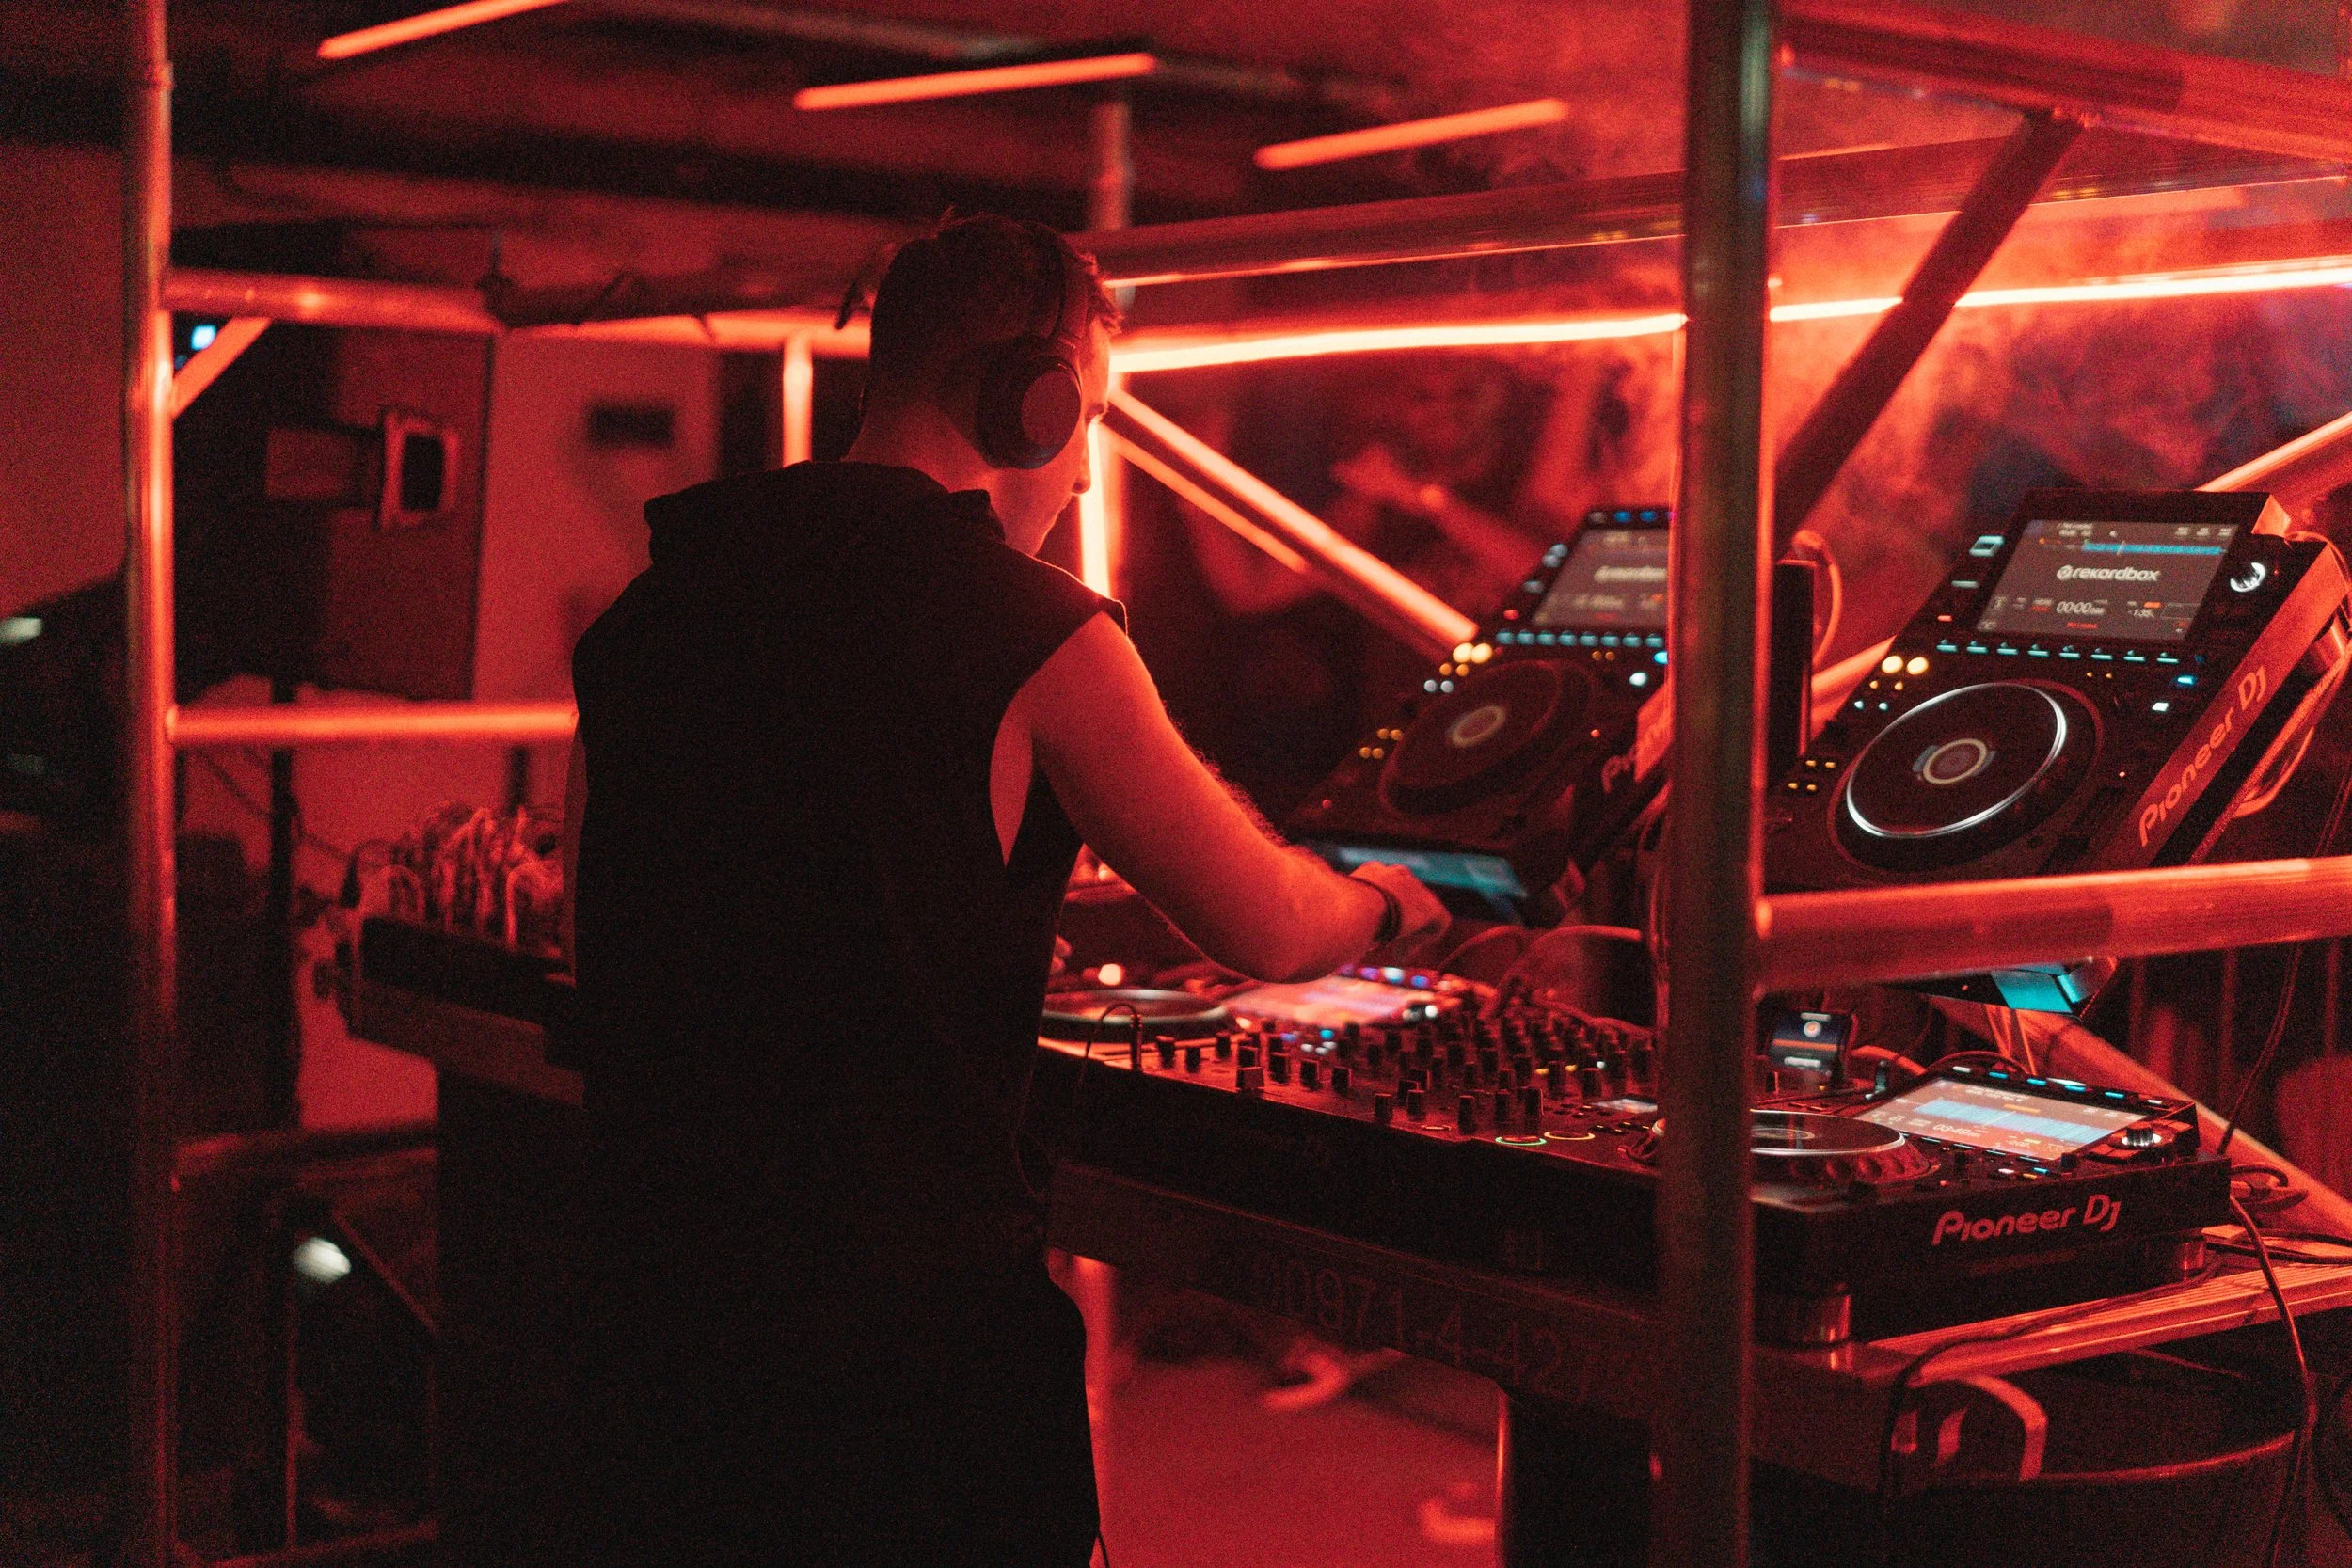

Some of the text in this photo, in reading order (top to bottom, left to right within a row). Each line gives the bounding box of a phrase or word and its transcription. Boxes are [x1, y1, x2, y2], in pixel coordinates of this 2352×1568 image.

[2072, 567, 2161, 581] rekordbox
[2139, 706, 2233, 847] Pioneer
[1931, 1194, 2122, 1246] Pioneer DJ
